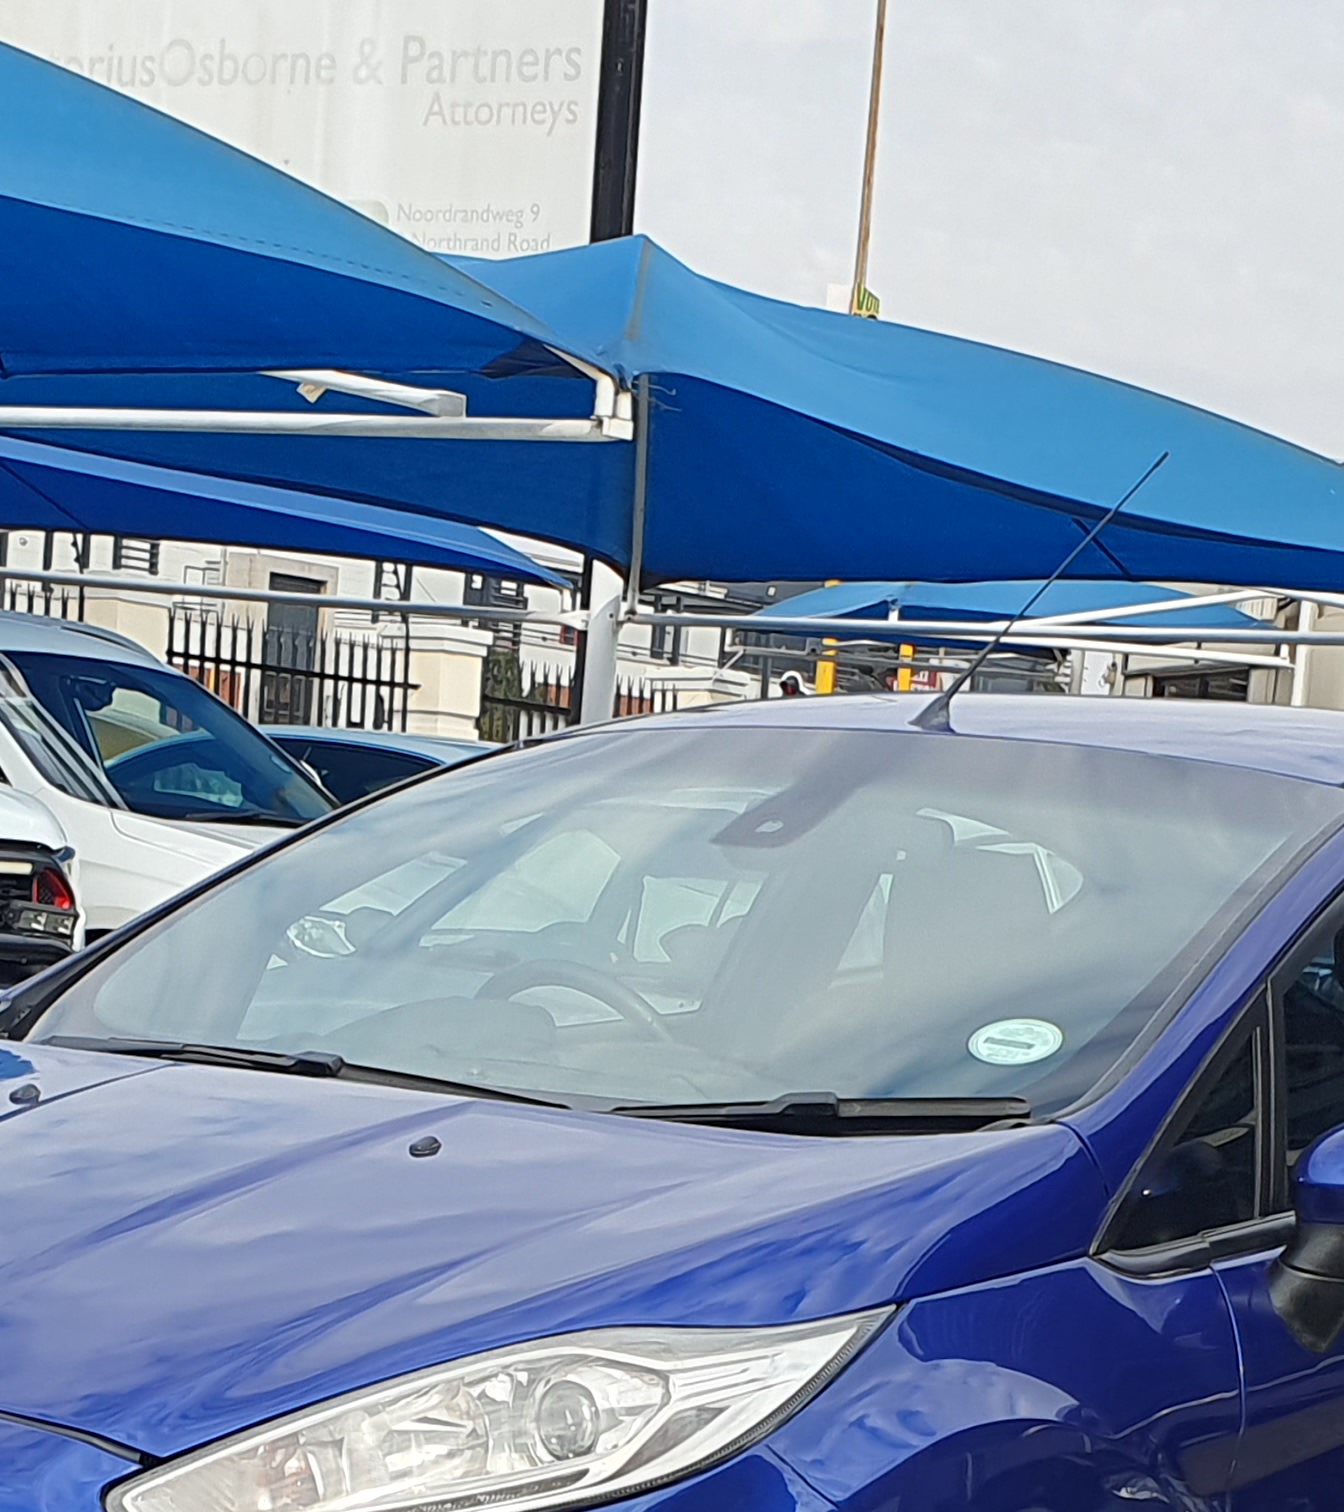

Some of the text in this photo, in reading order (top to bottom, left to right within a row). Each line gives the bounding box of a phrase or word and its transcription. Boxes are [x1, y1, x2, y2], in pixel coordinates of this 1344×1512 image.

[352, 37, 384, 86] &
[400, 34, 583, 85] Partners
[422, 91, 580, 138] Attorneys
[396, 202, 542, 230] Noordrandweg 9
[507, 231, 552, 252] Road
